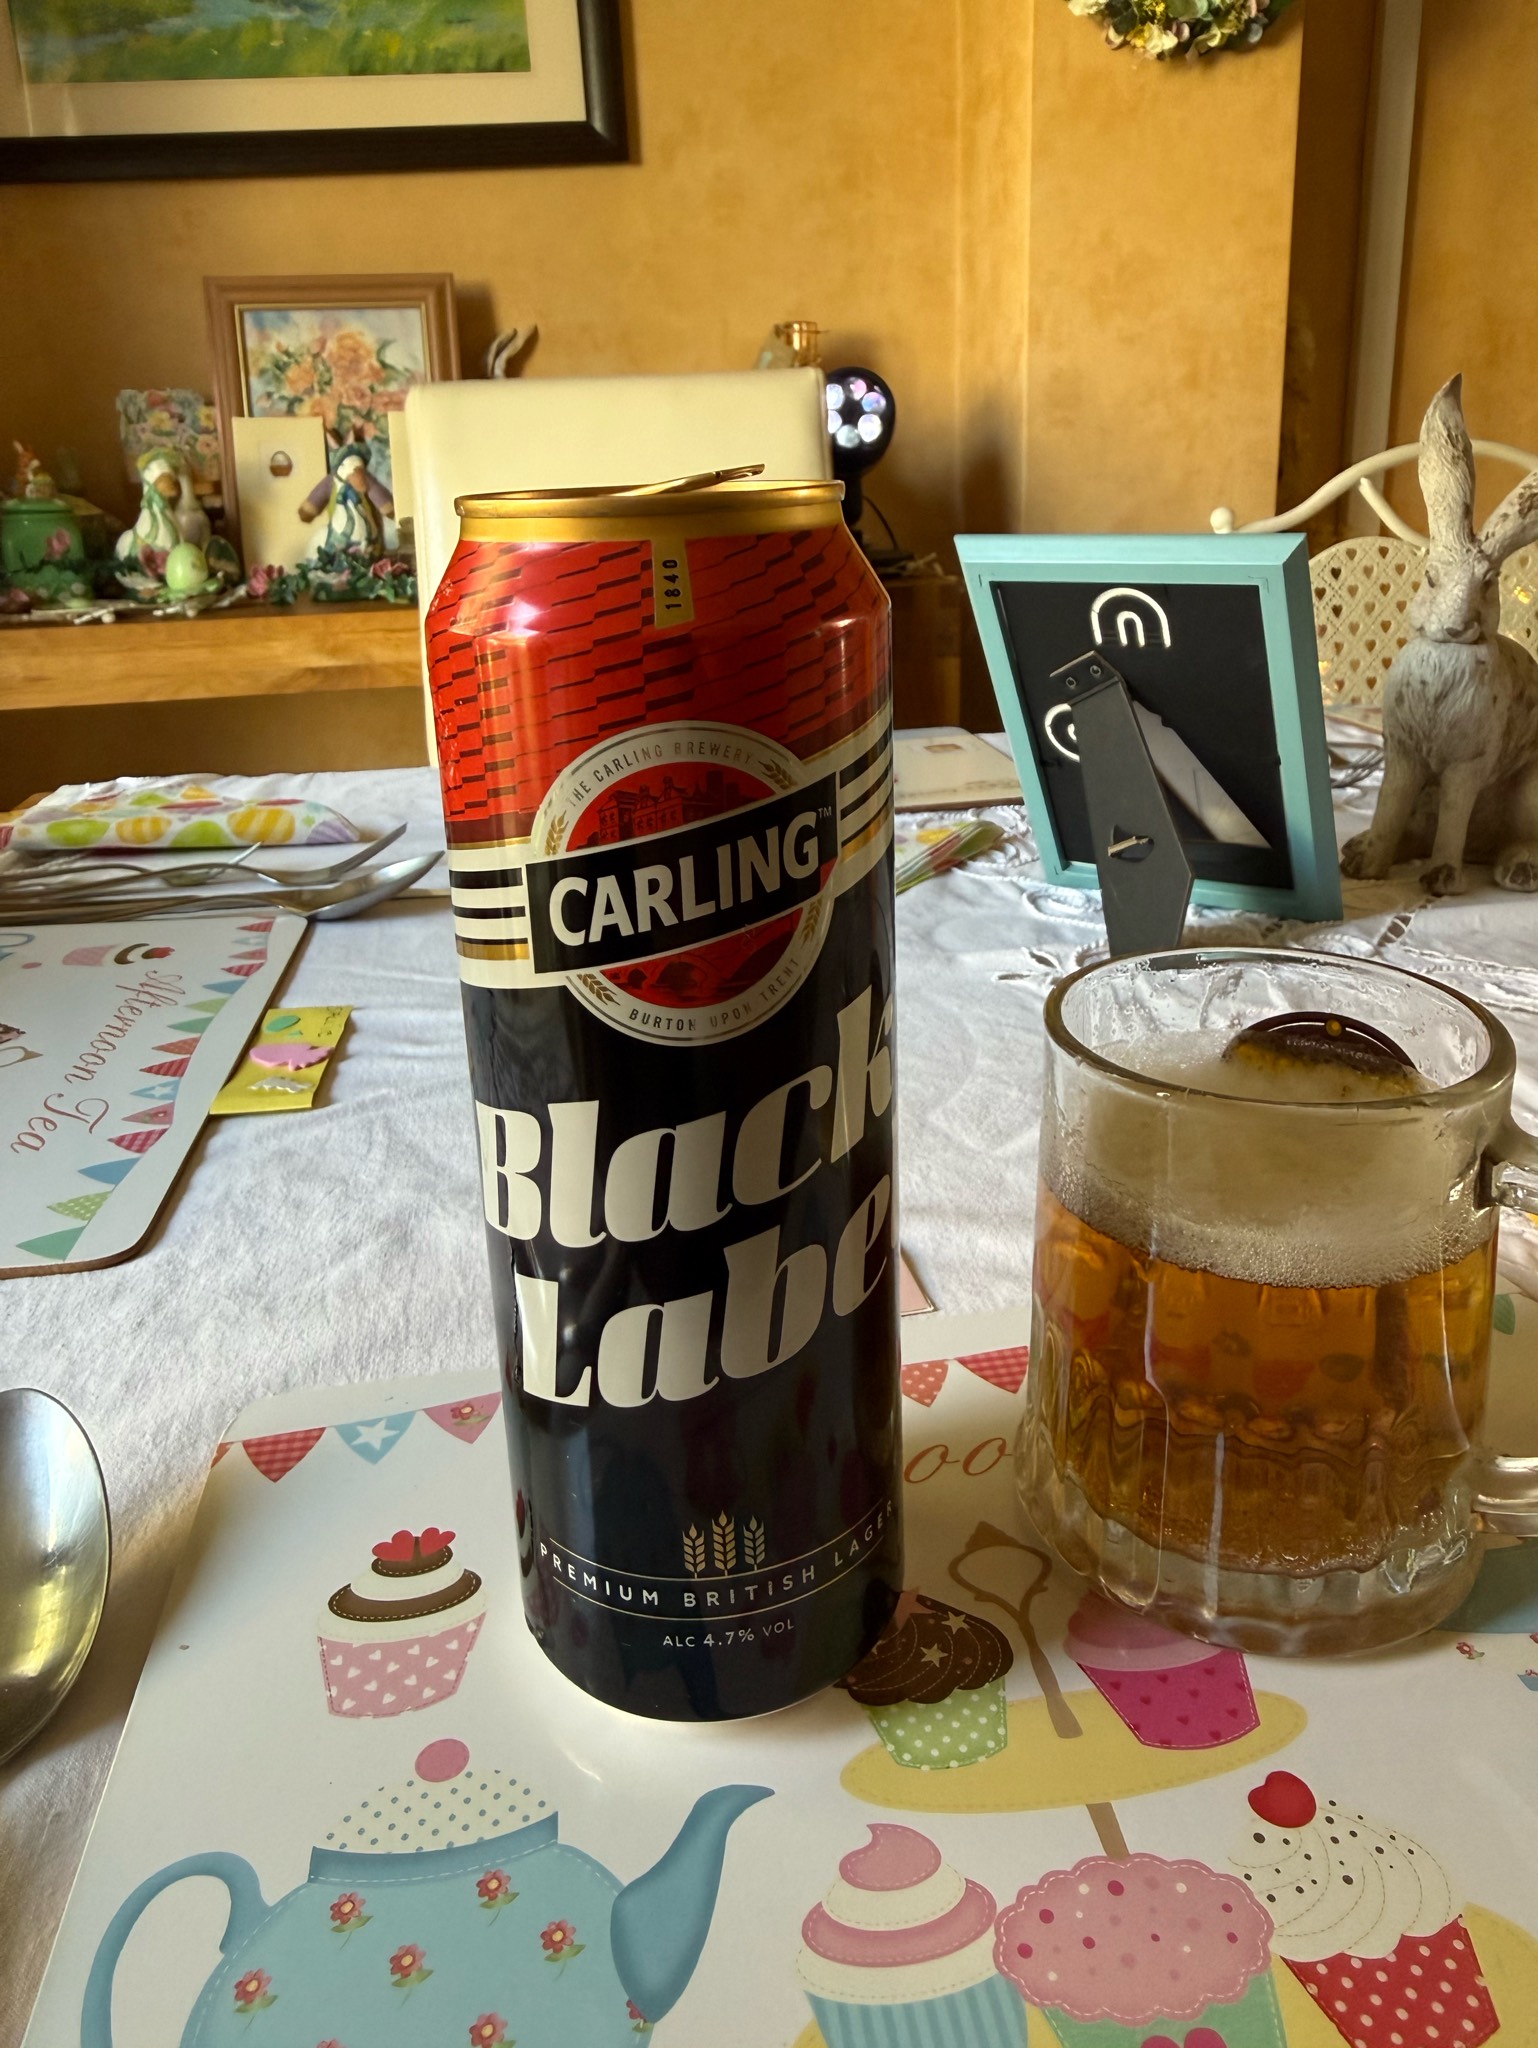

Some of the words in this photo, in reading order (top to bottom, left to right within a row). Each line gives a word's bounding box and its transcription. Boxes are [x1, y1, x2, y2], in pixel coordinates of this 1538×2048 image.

[662, 559, 682, 610] 1840
[568, 781, 592, 808] THE
[593, 744, 663, 783] CARLING
[674, 742, 754, 765] BREWERY
[549, 811, 820, 946] CARLING
[64, 969, 187, 1085] Afternoon
[628, 1008, 697, 1031] BURTON
[709, 1003, 754, 1028] UPON
[760, 958, 800, 1002] TRENT
[10, 1092, 110, 1154] Tea
[475, 984, 893, 1249] Black
[515, 1173, 892, 1408] Labe
[539, 1541, 659, 1607] PREMIUM
[683, 1565, 816, 1608] BRITISH
[833, 1499, 893, 1568] LAGER
[662, 1634, 696, 1648] ALC
[702, 1627, 756, 1648] 4.7%
[762, 1620, 795, 1638] VOL
